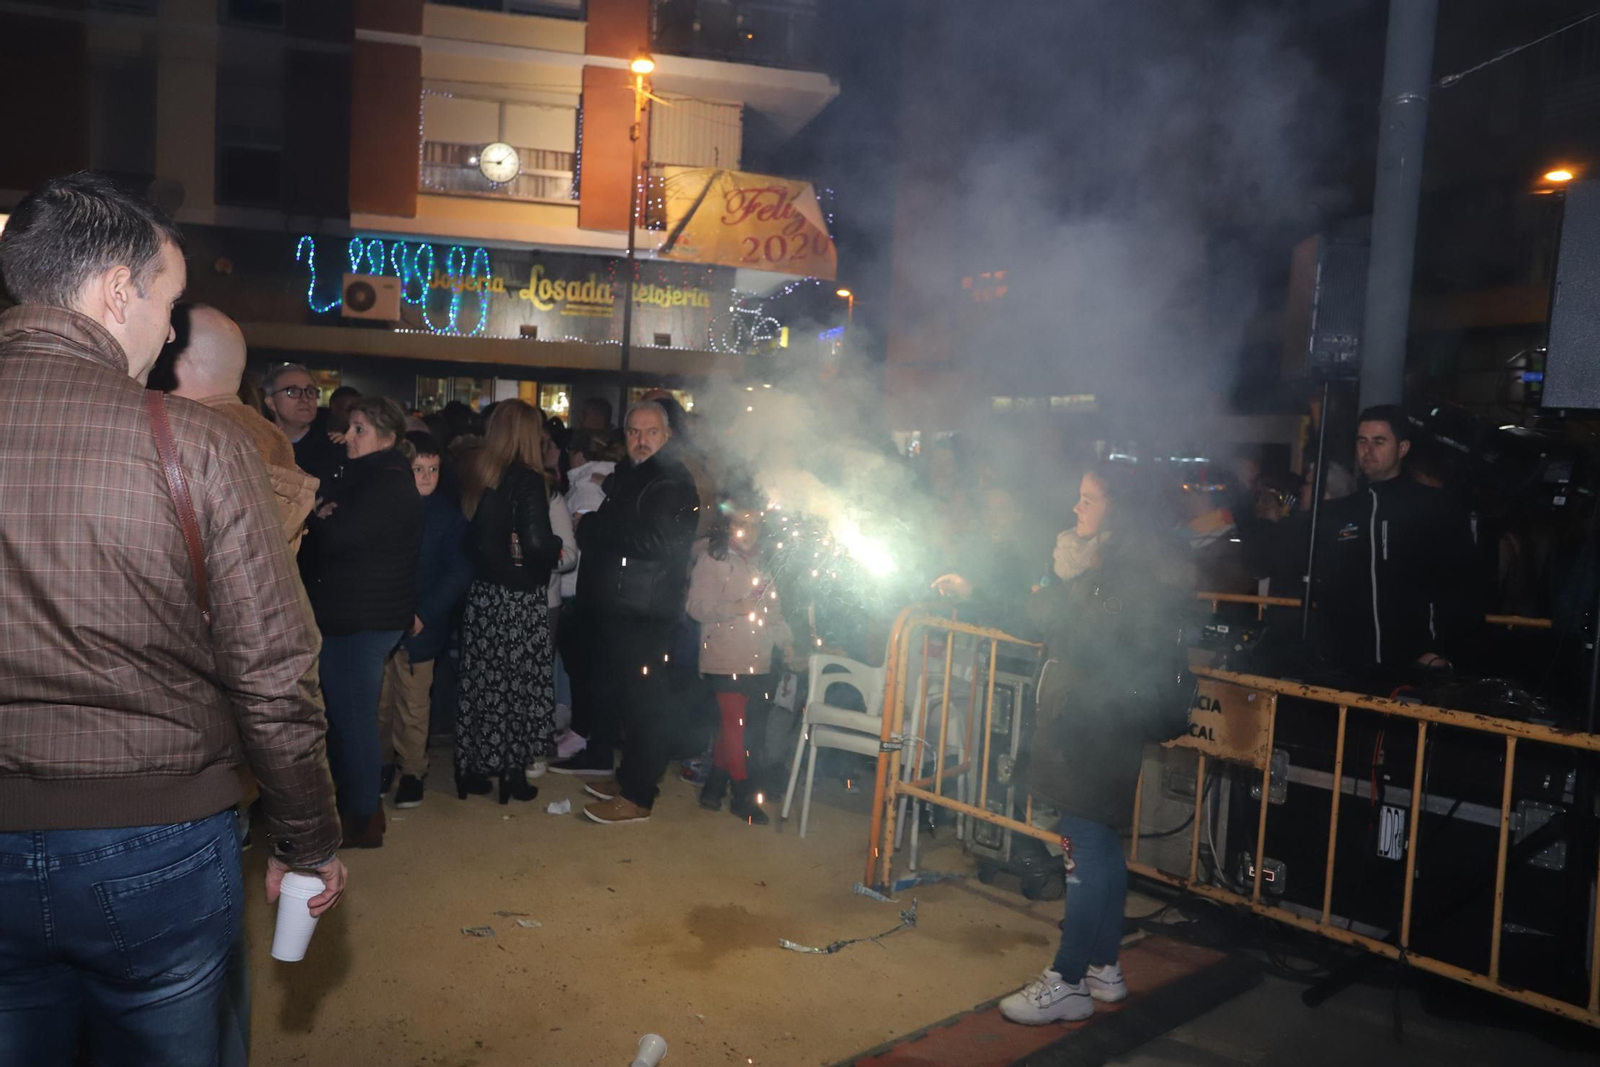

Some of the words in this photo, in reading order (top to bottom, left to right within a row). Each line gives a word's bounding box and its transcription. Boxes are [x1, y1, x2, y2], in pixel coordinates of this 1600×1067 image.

[741, 231, 829, 264] 2020
[519, 264, 614, 311] Losada
[1189, 723, 1215, 742] CAL
